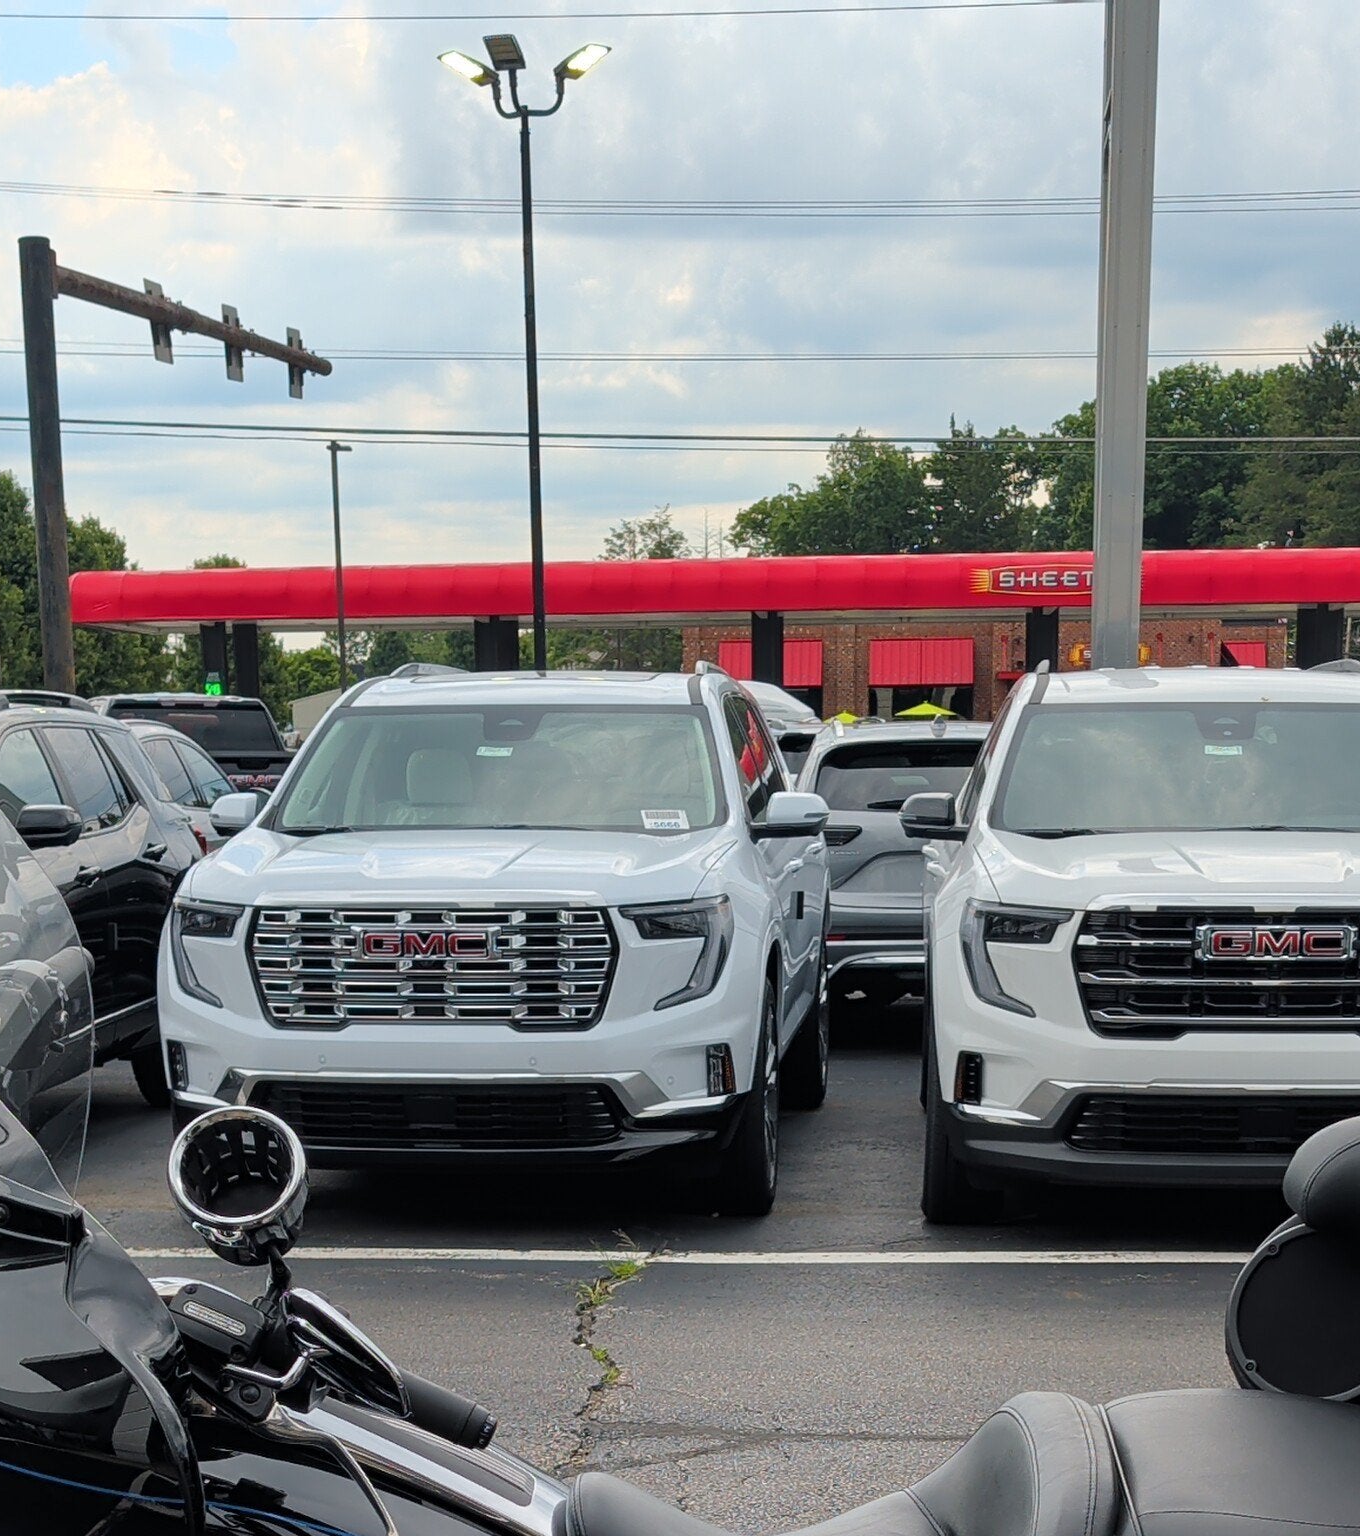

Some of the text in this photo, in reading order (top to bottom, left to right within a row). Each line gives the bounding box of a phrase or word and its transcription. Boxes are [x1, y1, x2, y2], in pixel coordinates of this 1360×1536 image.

[999, 570, 1093, 588] SHEET
[364, 932, 487, 957] GMC
[1211, 931, 1345, 957] GMC
